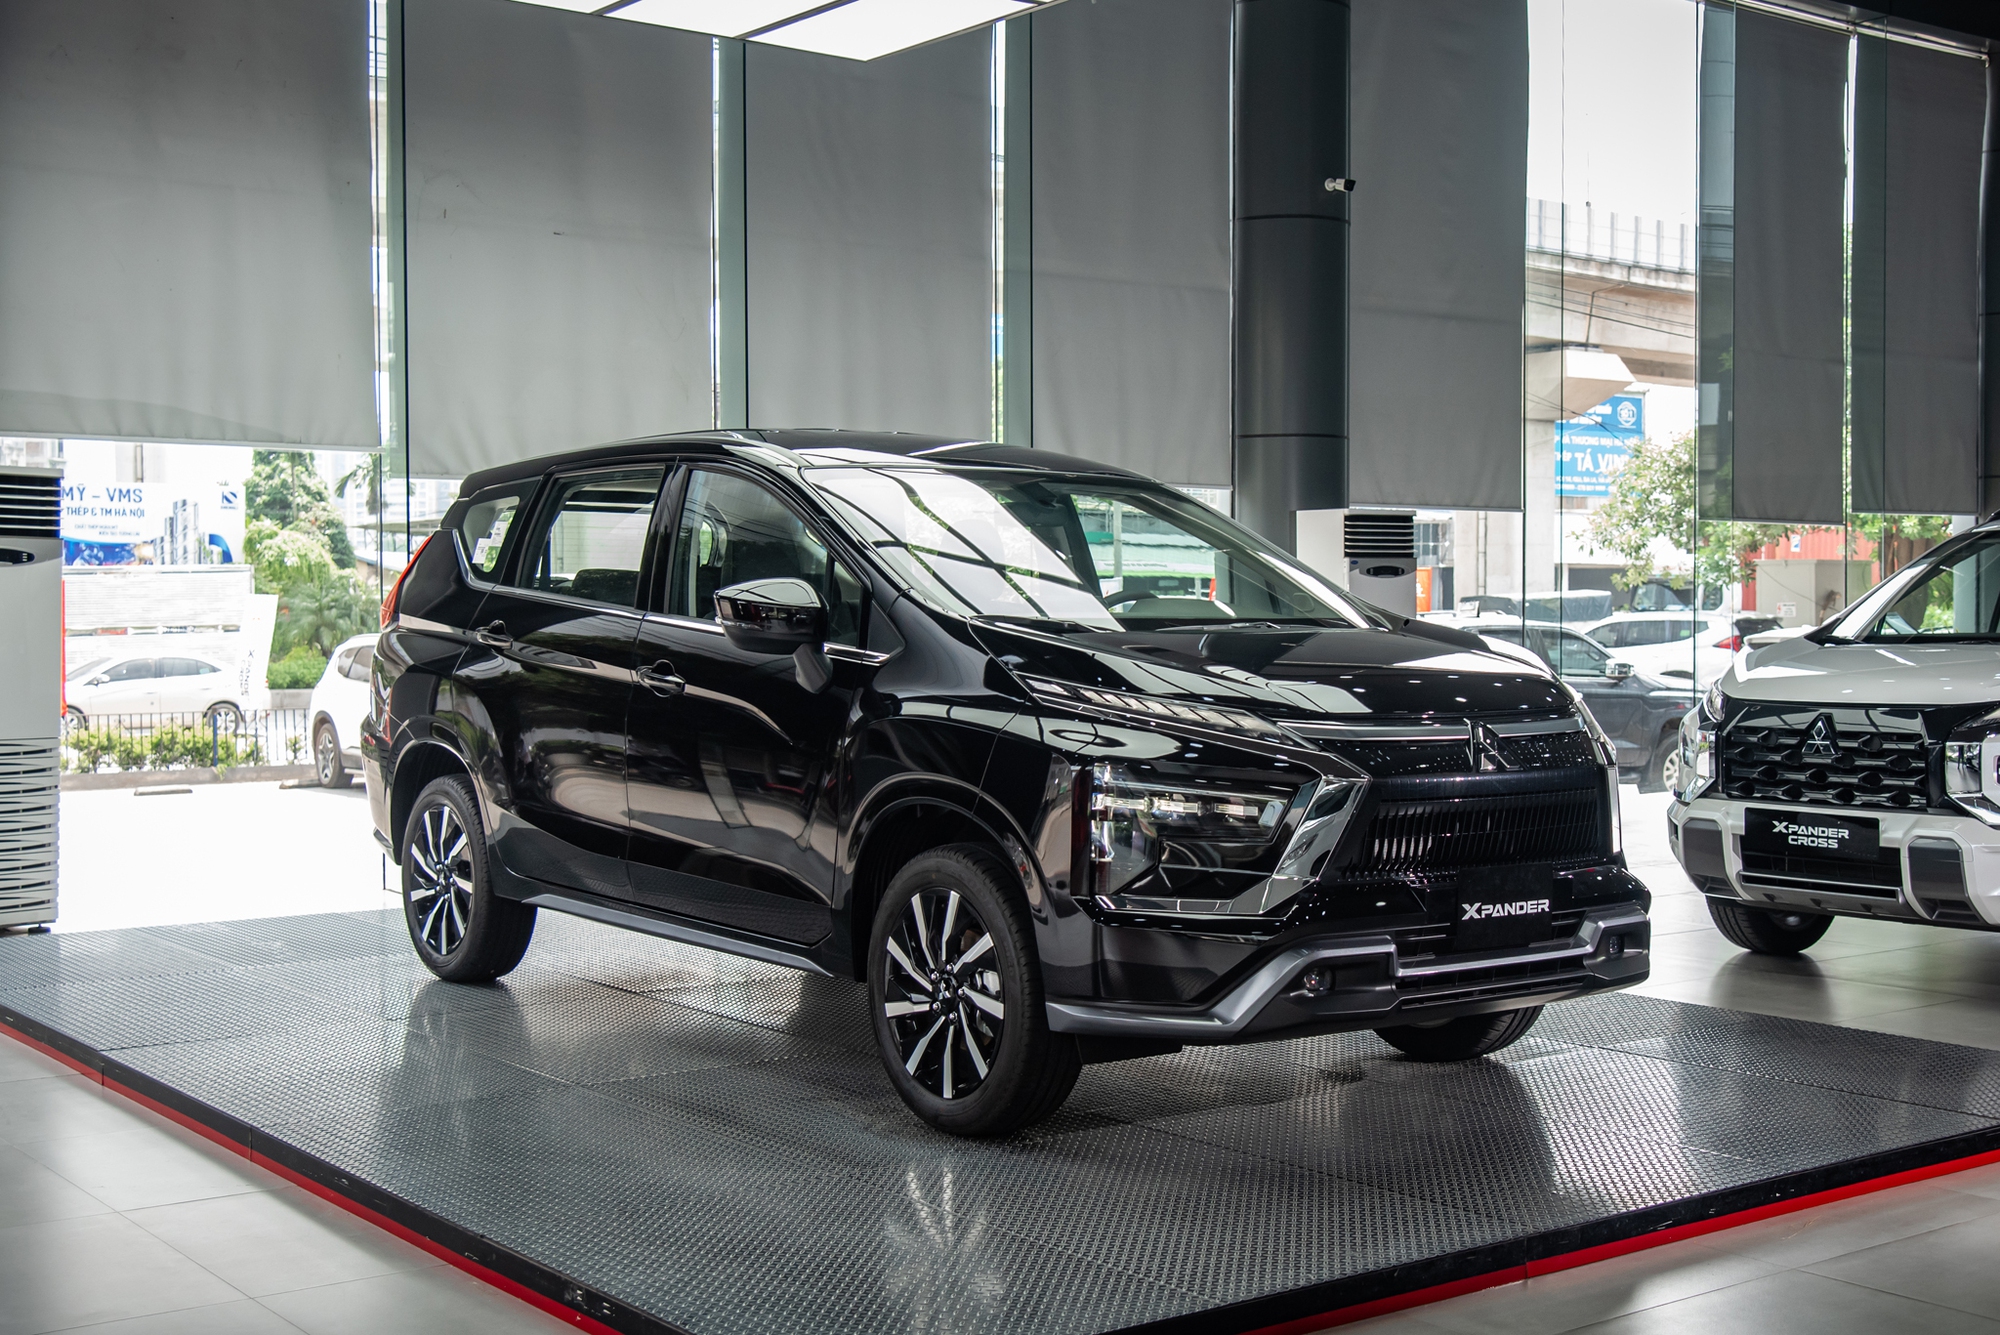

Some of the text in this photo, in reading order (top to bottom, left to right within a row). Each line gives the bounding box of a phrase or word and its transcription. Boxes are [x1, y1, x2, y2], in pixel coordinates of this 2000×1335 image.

[1574, 448, 1595, 472] TÁ
[61, 483, 86, 501] MỸ
[106, 487, 143, 503] VMS
[66, 505, 89, 517] THÉP
[100, 507, 113, 517] TM
[114, 507, 127, 518] HÀ
[129, 508, 145, 519] NỘI
[1772, 820, 1850, 839] XPANDER
[1788, 835, 1839, 849] CROSS
[1461, 898, 1550, 921] XPANDER
